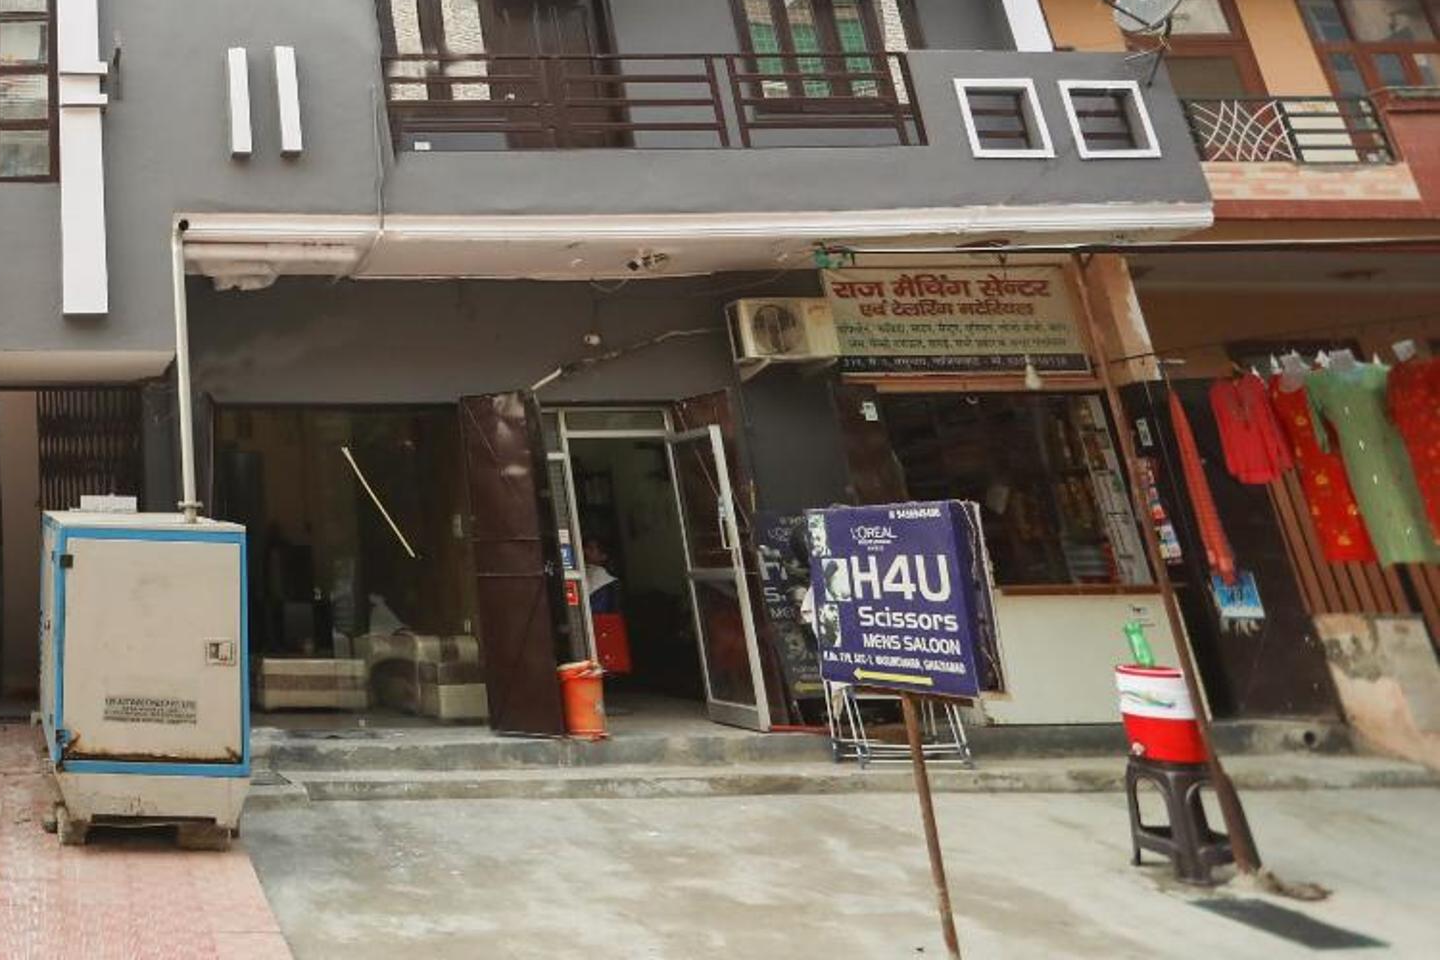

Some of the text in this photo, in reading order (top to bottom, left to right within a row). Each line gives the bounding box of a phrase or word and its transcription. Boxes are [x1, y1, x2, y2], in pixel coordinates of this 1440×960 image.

[850, 554, 952, 602] H4U
[858, 606, 959, 632] Scissors
[903, 635, 962, 656] SALOON
